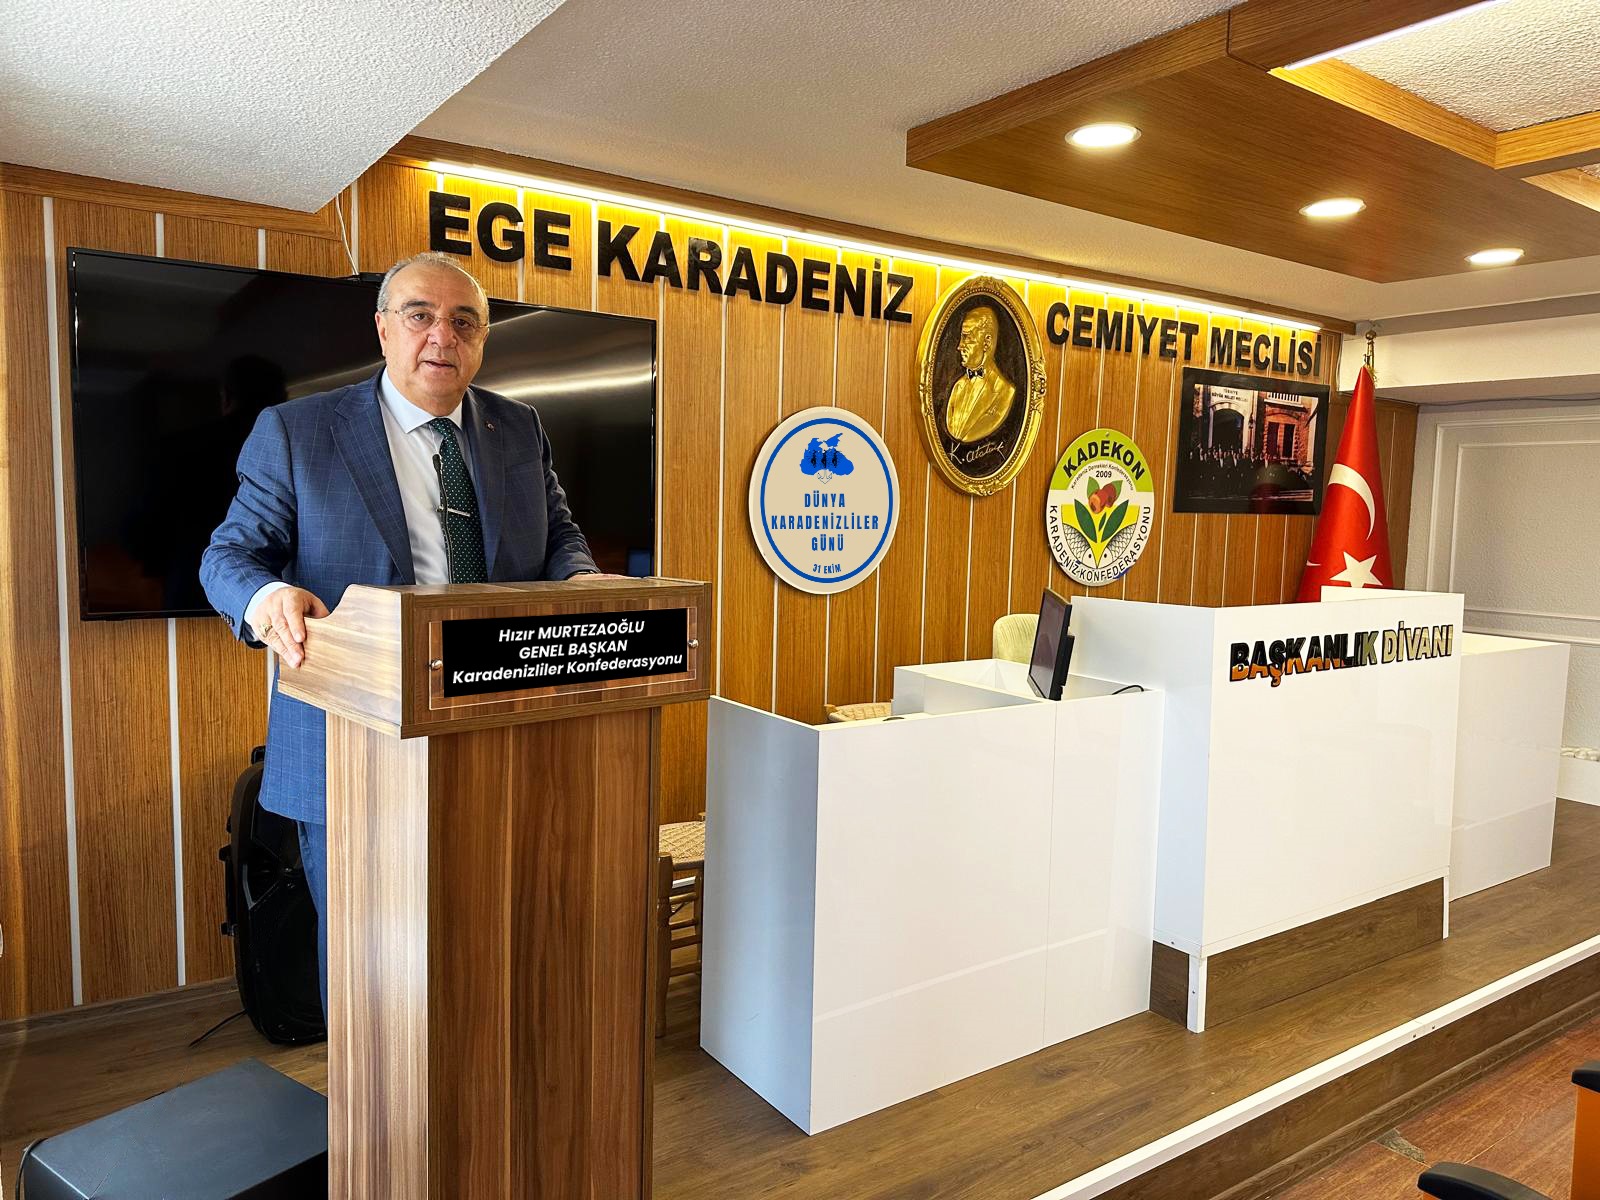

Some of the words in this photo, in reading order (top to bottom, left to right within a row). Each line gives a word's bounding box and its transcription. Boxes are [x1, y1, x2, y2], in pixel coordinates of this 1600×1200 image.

[428, 190, 573, 271] EGE
[598, 219, 914, 323] KARADENİZ
[1046, 302, 1199, 361] CEMİYET
[1210, 327, 1322, 377] MECLİSİ
[1062, 440, 1145, 481] KADEKON
[1095, 470, 1112, 478] 2009
[804, 490, 846, 508] DÜNYA
[771, 512, 879, 530] KARADENİZLİLER
[811, 534, 844, 551] GÜNÜ
[812, 563, 821, 573] 31
[823, 563, 842, 574] EKİM
[498, 628, 535, 643] Hızır
[537, 618, 645, 640] MURTEZAOĞLU
[519, 644, 565, 660] GENEL
[568, 639, 628, 658] BAŞKAN
[1229, 630, 1379, 687] BAŞKANLIK
[1381, 620, 1454, 664] DİVANI
[452, 663, 564, 684] Karadenizliler
[566, 654, 683, 674] Konfederasyonu
